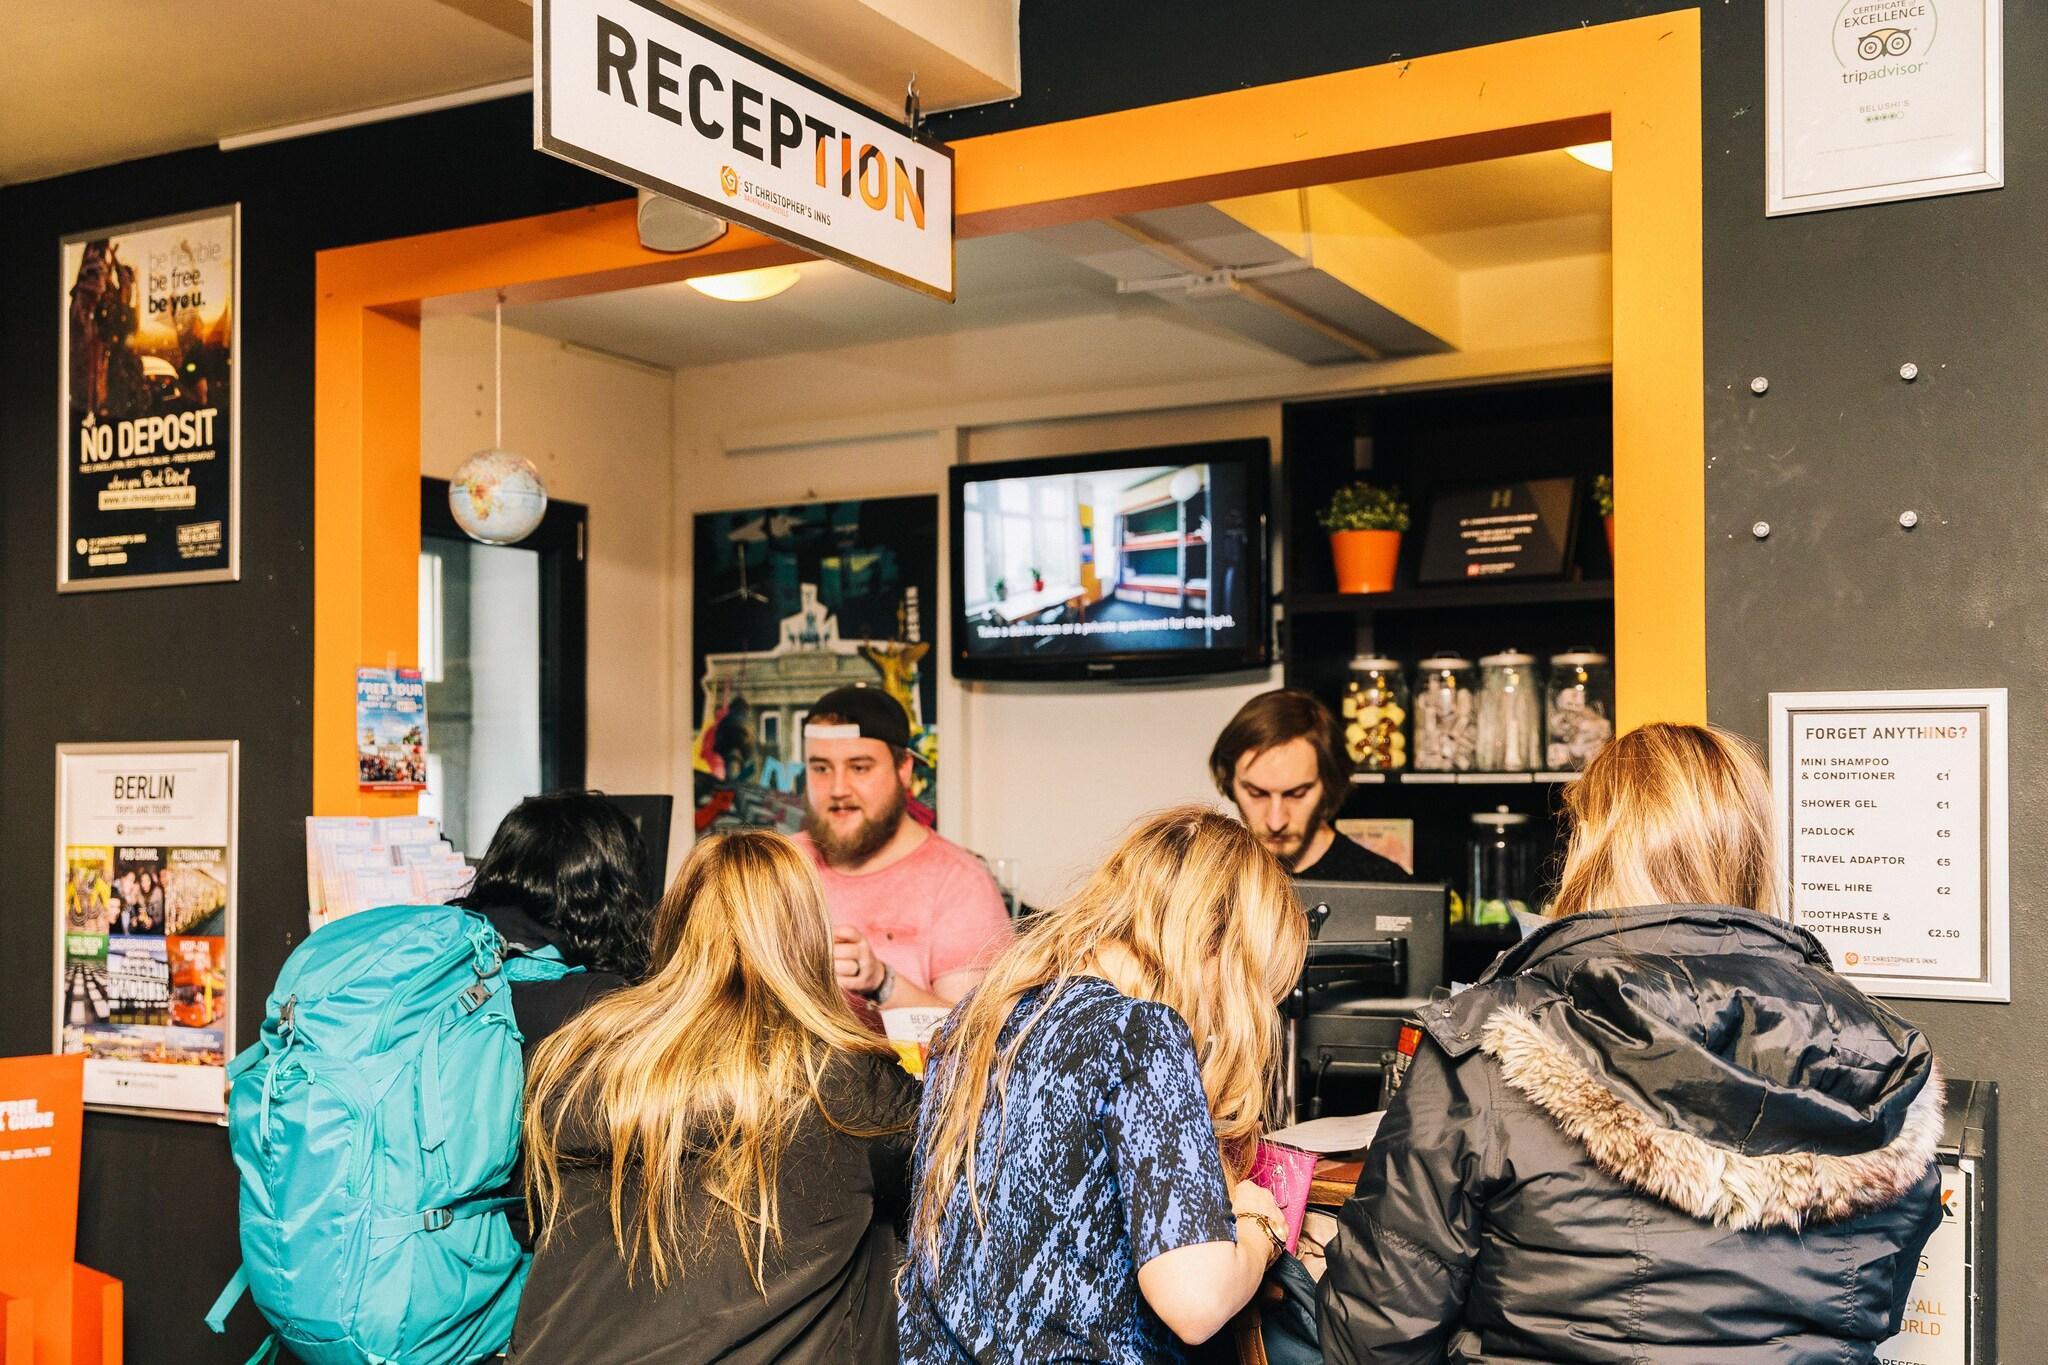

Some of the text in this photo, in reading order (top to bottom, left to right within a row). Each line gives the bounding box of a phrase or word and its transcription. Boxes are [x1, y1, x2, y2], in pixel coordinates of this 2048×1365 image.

[1853, 1, 1905, 15] CERTIFICATE
[1844, 6, 1925, 28] EXCELLENCE
[1841, 62, 1924, 85] tripadvisor
[596, 14, 925, 231] RECEPTION
[744, 181, 831, 226] ST CHRISTOPHER'S INNS
[149, 271, 167, 293] be
[149, 292, 206, 317] be you.
[81, 408, 218, 463] NO DEPOSIT
[1169, 616, 1184, 630] for
[1185, 615, 1203, 629] the
[392, 683, 423, 697] TOUR
[1806, 726, 1968, 740] FORGET ANYTHING?
[1801, 758, 1889, 766] MINI SHAMPOO
[1801, 772, 1950, 781] & CONDITIONER €1
[114, 775, 175, 799] BERLIN
[1801, 800, 1950, 810] SHOWER GEL €1
[1801, 828, 1951, 838] PADLOCK €5
[1801, 855, 1951, 866] TRAVEL ADAPTOR €5
[1801, 883, 1951, 895] TOWEL HIRE €2
[1801, 910, 1891, 921] TOOTHPASTE &
[1928, 929, 1960, 939] €2.50
[1915, 1298, 1948, 1316] ALL
[1900, 1318, 1941, 1336] ORLD
